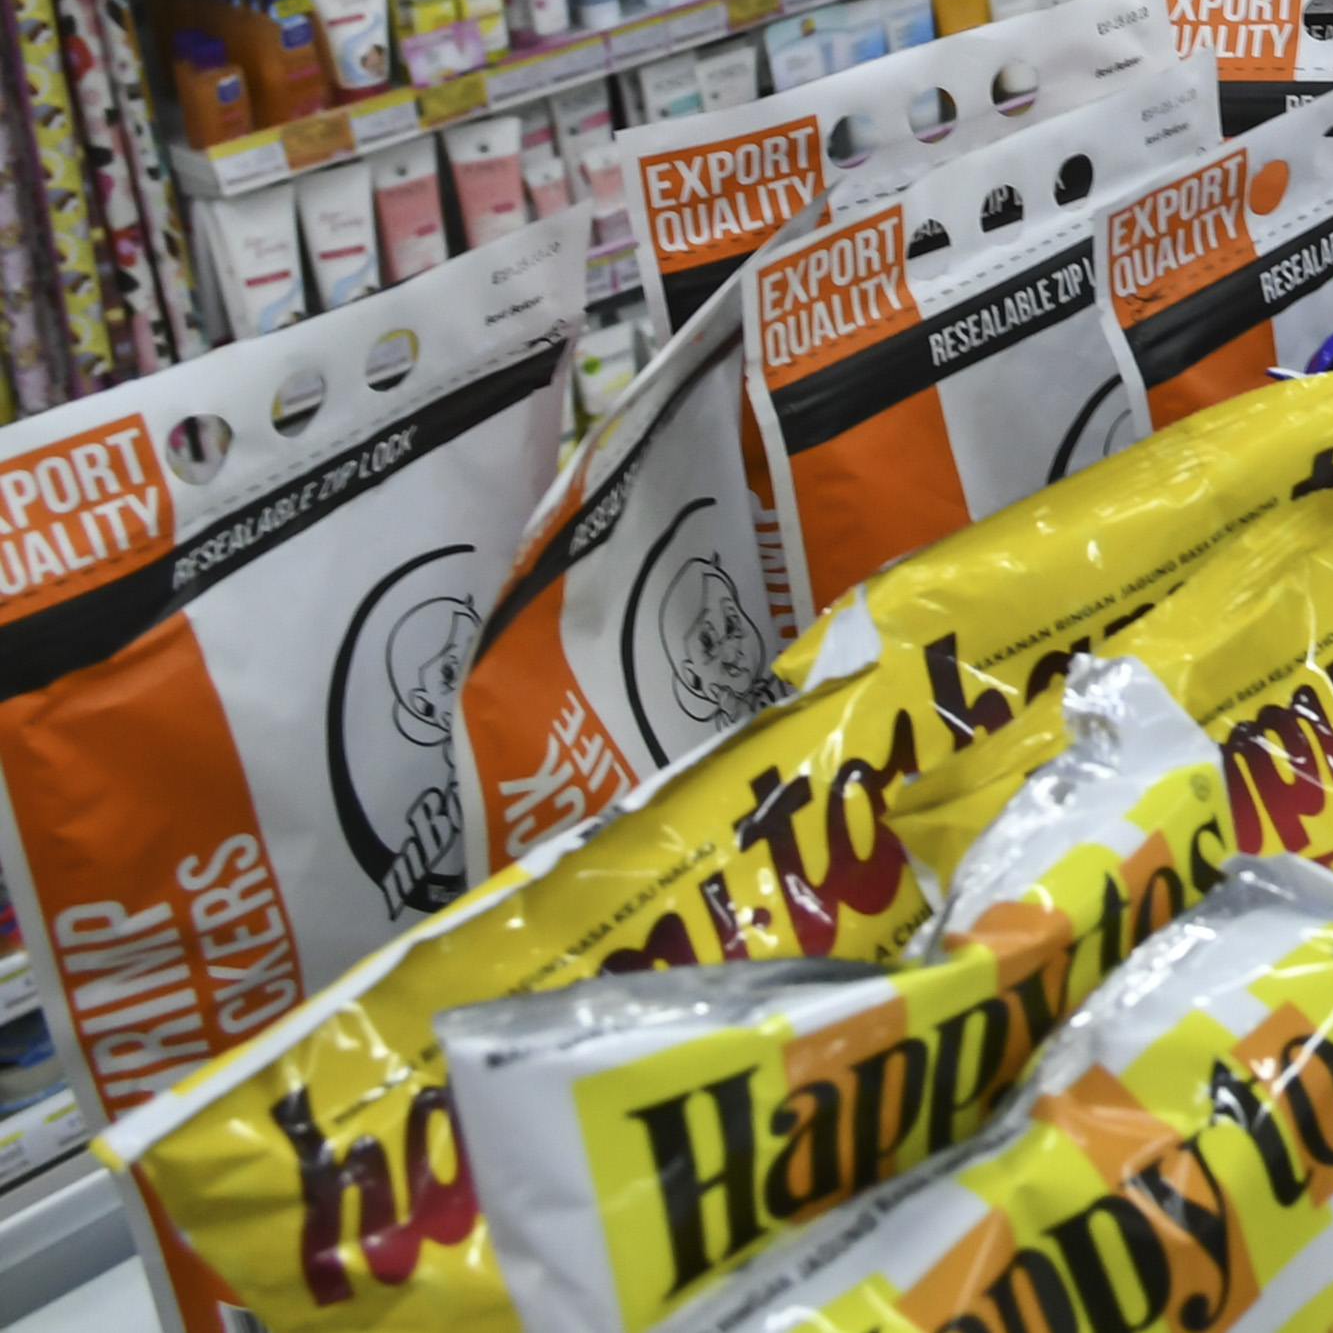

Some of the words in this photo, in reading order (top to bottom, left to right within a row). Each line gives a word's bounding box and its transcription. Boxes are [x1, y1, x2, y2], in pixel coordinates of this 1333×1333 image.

[1172, 24, 1294, 59] UALITY
[648, 124, 816, 211] EXPORT
[654, 171, 819, 248] QUALITY
[1110, 152, 1247, 255] EXPORT
[759, 215, 899, 320] EXPORT
[1114, 199, 1246, 299] QUALITY
[763, 263, 903, 367] QUALITY
[929, 273, 1054, 366] RESEALABLE
[1051, 263, 1085, 308] ZIP
[0, 485, 161, 596] UALITY
[172, 477, 315, 591] RESEALABLE
[317, 457, 358, 504] ZIP
[359, 424, 420, 479] LOCK
[1055, 596, 1117, 631] RINGAN
[1119, 559, 1179, 600] JAGUNG
[176, 832, 297, 1035] CKERS
[56, 899, 211, 1121] HRIMP
